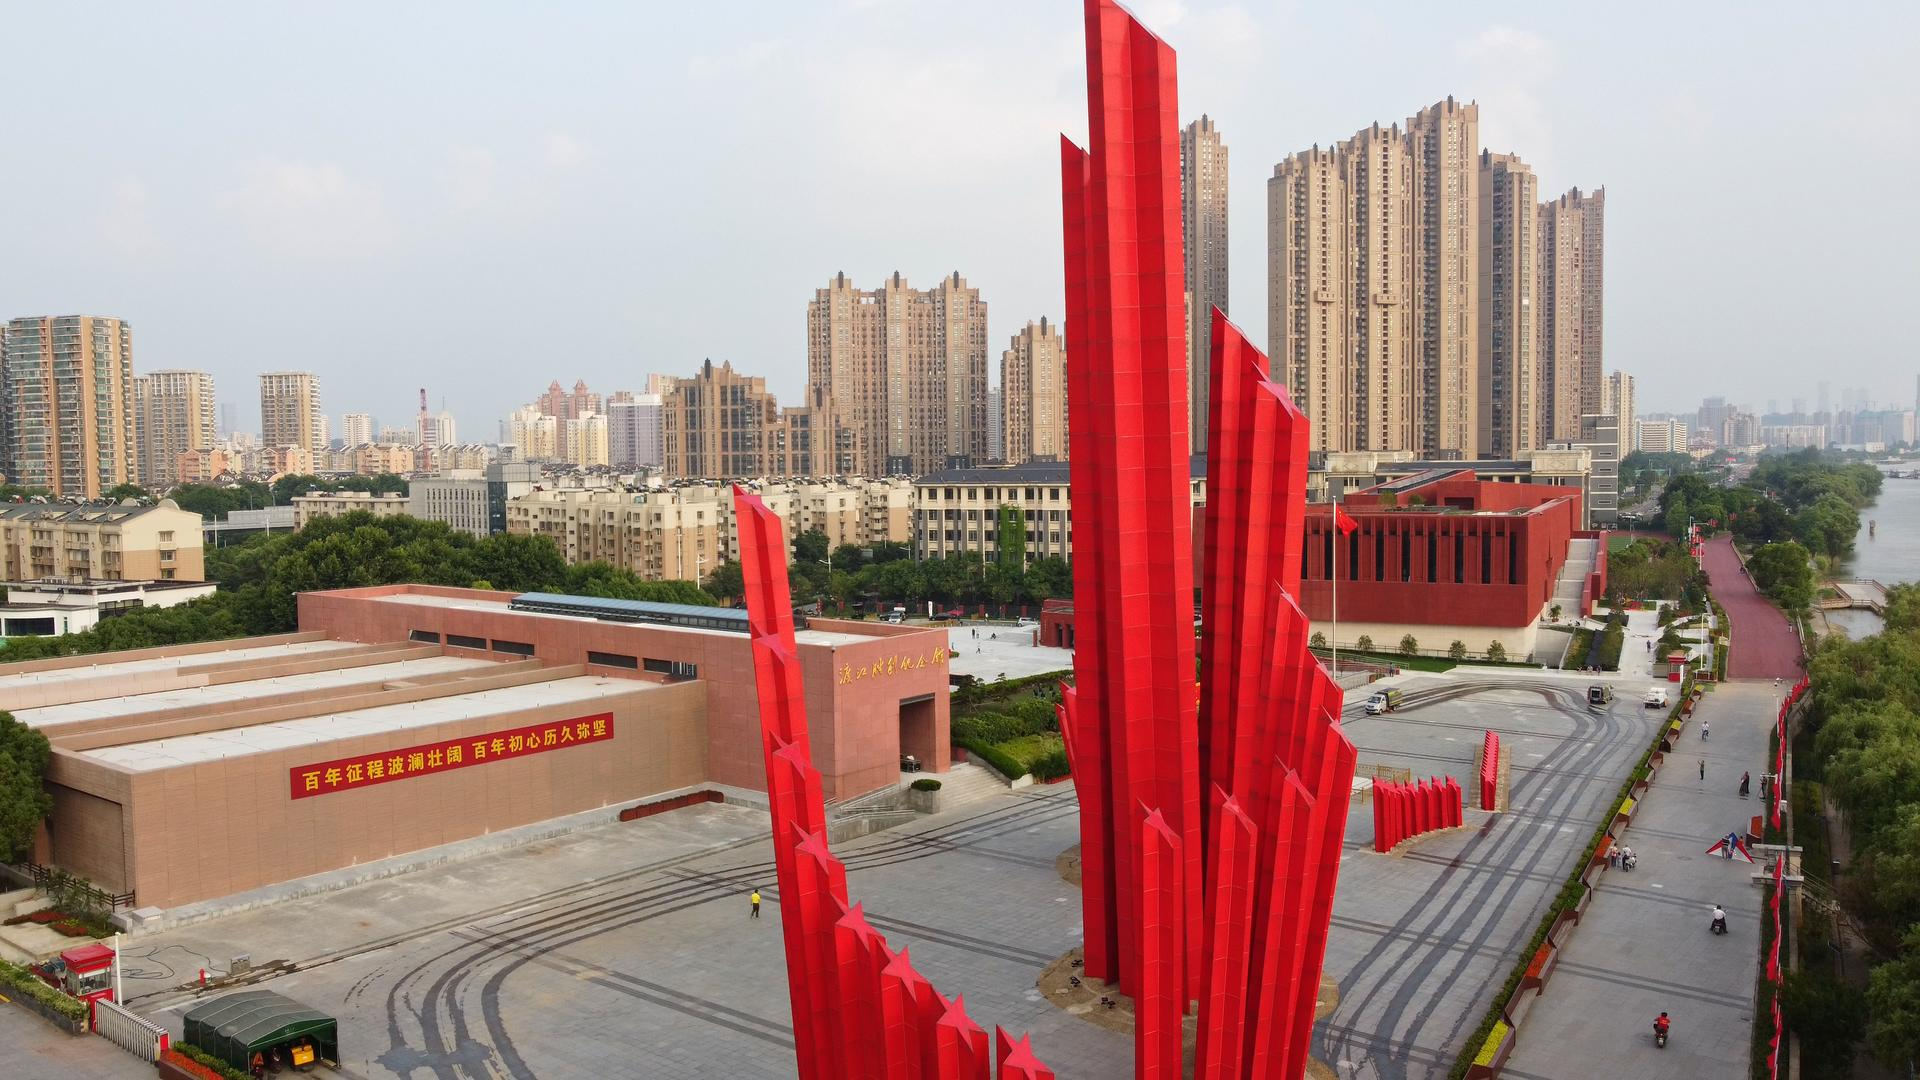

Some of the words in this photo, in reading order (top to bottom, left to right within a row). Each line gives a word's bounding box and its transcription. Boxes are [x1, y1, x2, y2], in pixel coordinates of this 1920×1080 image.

[302, 745, 462, 791] 百年征程波澜壮阔
[472, 719, 607, 759] 百年初心历久弥坚
